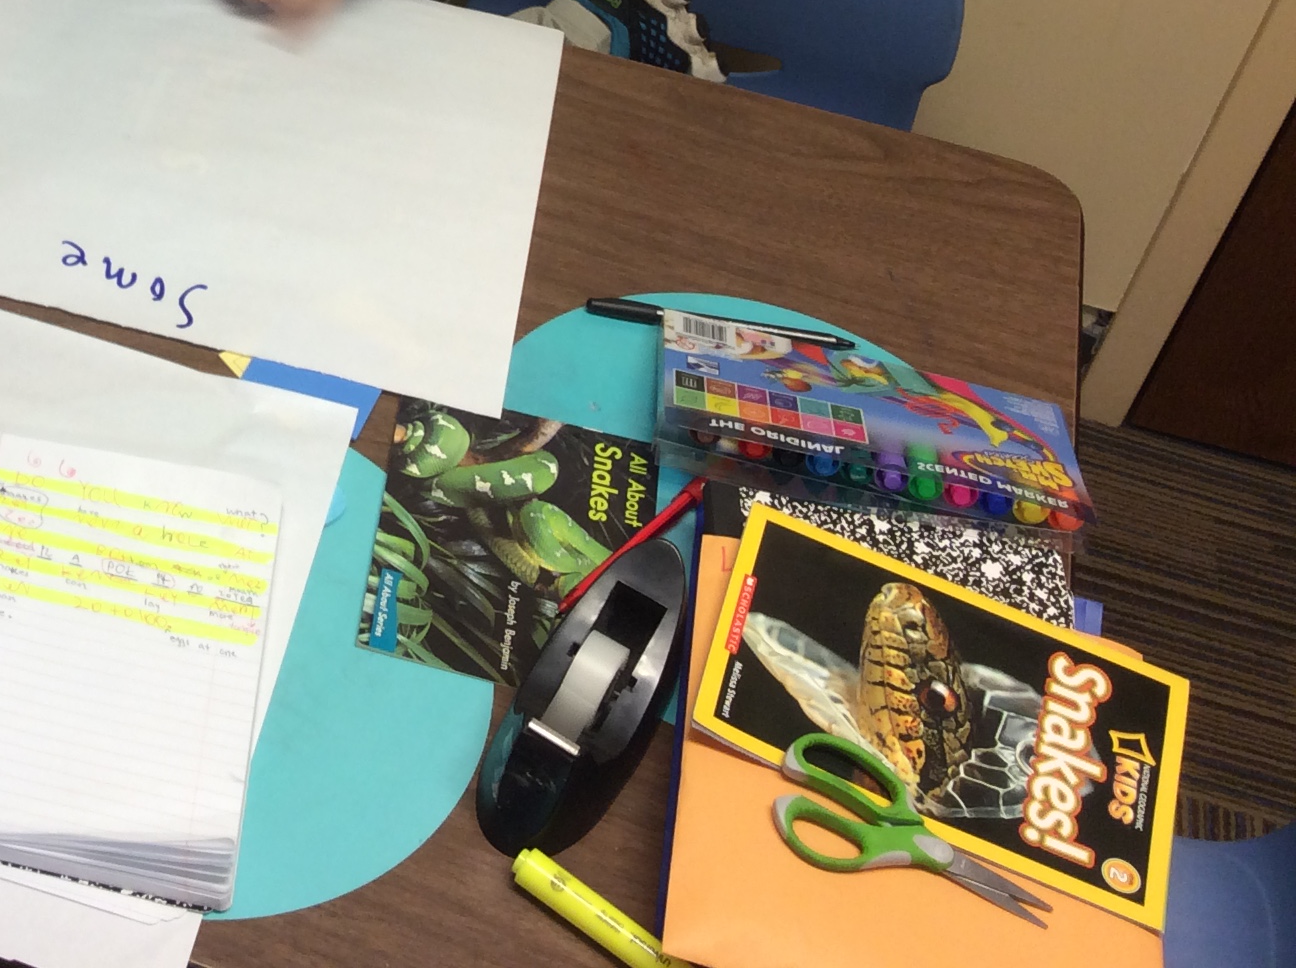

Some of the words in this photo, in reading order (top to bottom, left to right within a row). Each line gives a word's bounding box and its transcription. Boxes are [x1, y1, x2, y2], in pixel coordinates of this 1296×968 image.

[61, 239, 209, 328] Some
[588, 442, 623, 522] Snakes
[627, 451, 649, 477] All
[624, 478, 648, 529] About
[504, 593, 521, 627] Joseph
[727, 585, 753, 653] SCHOLASTIC
[499, 627, 517, 671] Benjamin
[1019, 650, 1114, 869] Snakes!
[1107, 755, 1141, 826] KIDS
[1109, 865, 1129, 884] 2
